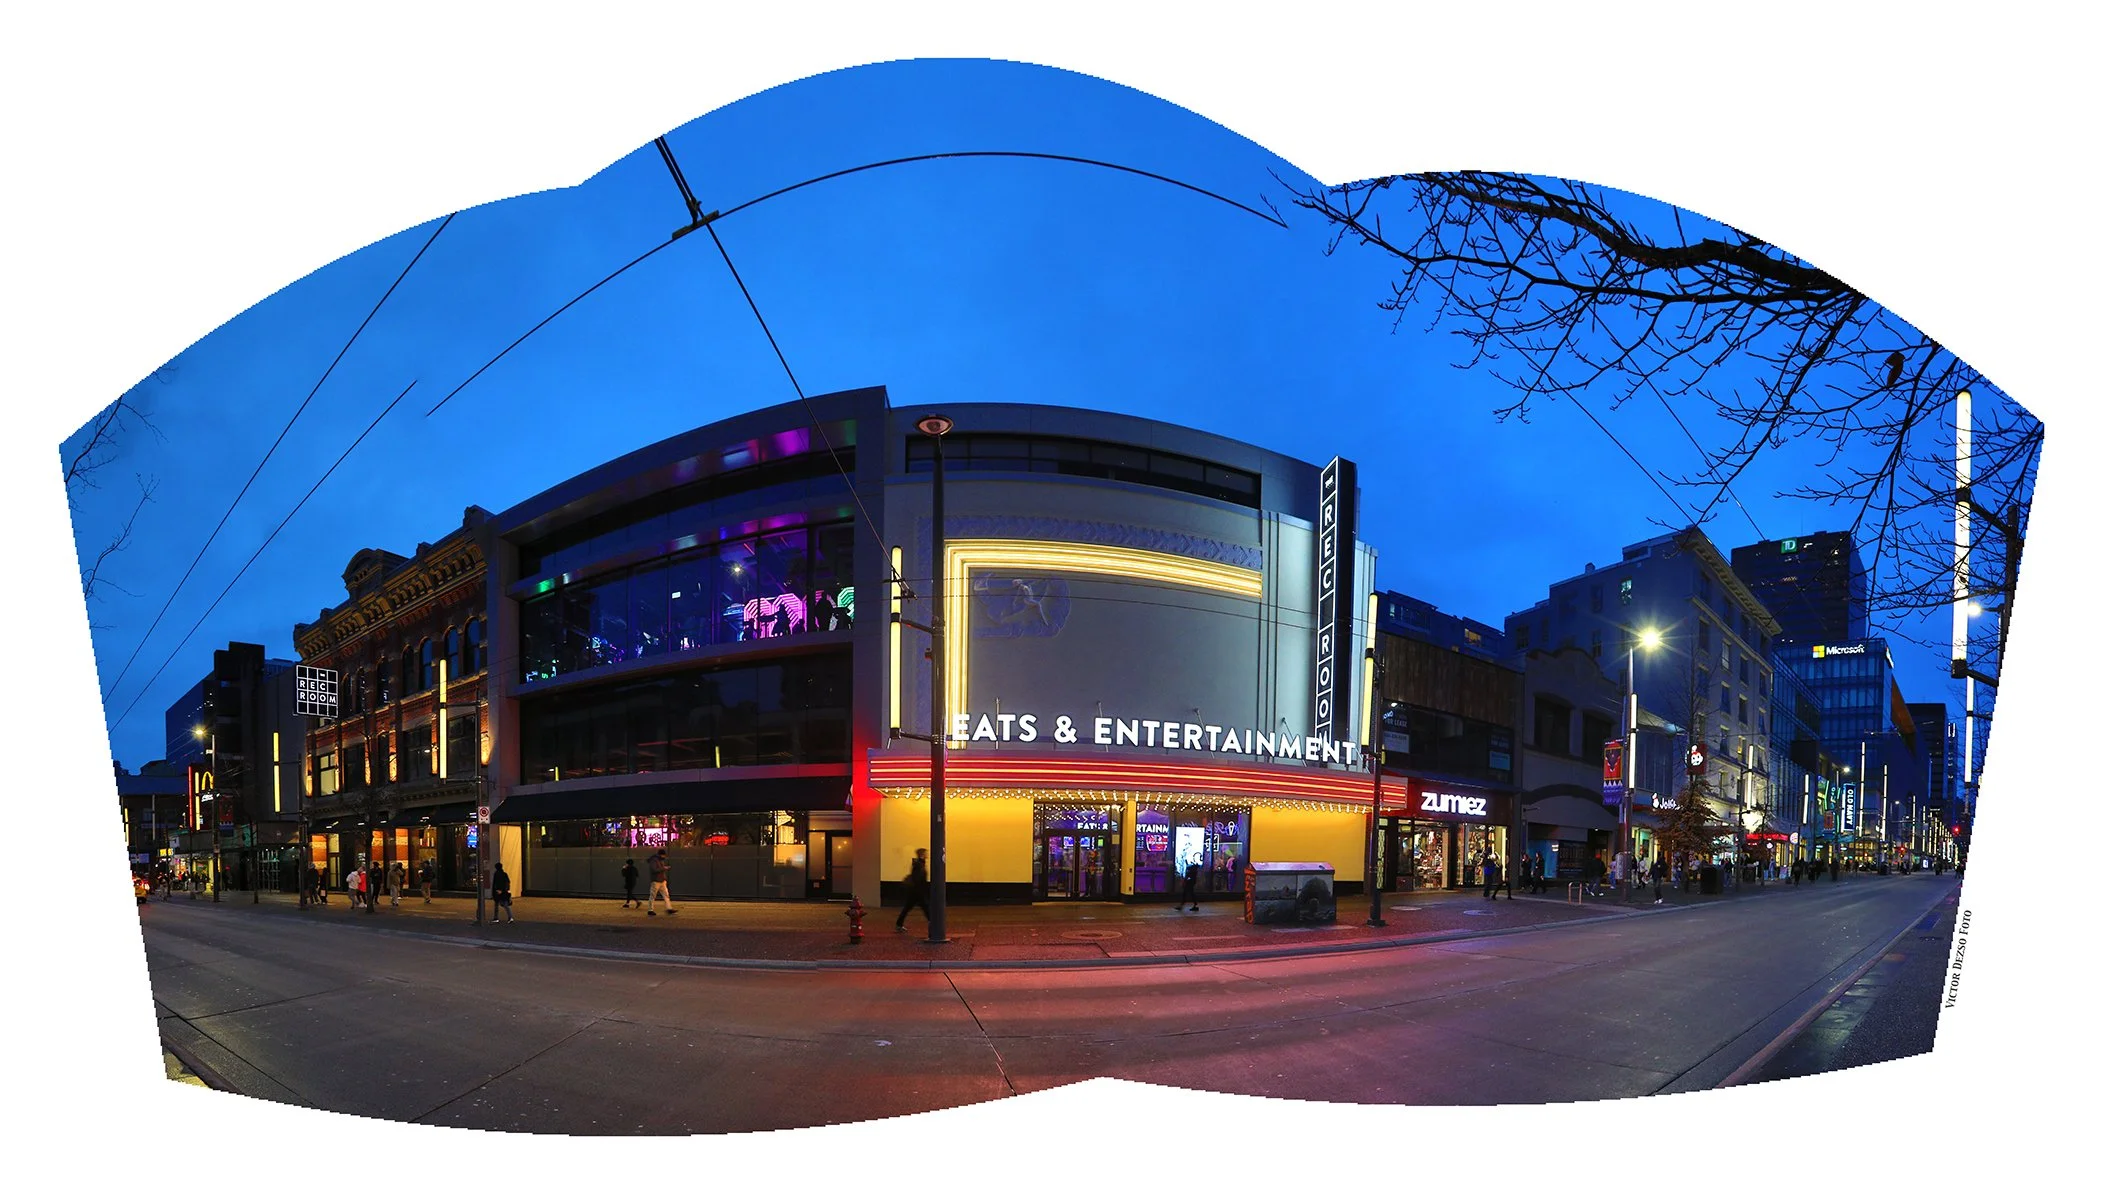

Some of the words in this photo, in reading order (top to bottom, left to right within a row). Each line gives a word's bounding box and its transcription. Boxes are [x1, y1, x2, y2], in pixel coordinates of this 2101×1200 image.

[1323, 503, 1333, 590] REC
[1783, 540, 1796, 550] TD
[1826, 644, 1865, 655] Microsoft
[300, 680, 326, 690] REC
[300, 692, 336, 703] ROOM
[952, 713, 1037, 742] EATS
[1053, 715, 1078, 744] &
[1094, 717, 1356, 765] ENTERTAINMENT
[1846, 804, 1854, 826] NAVY
